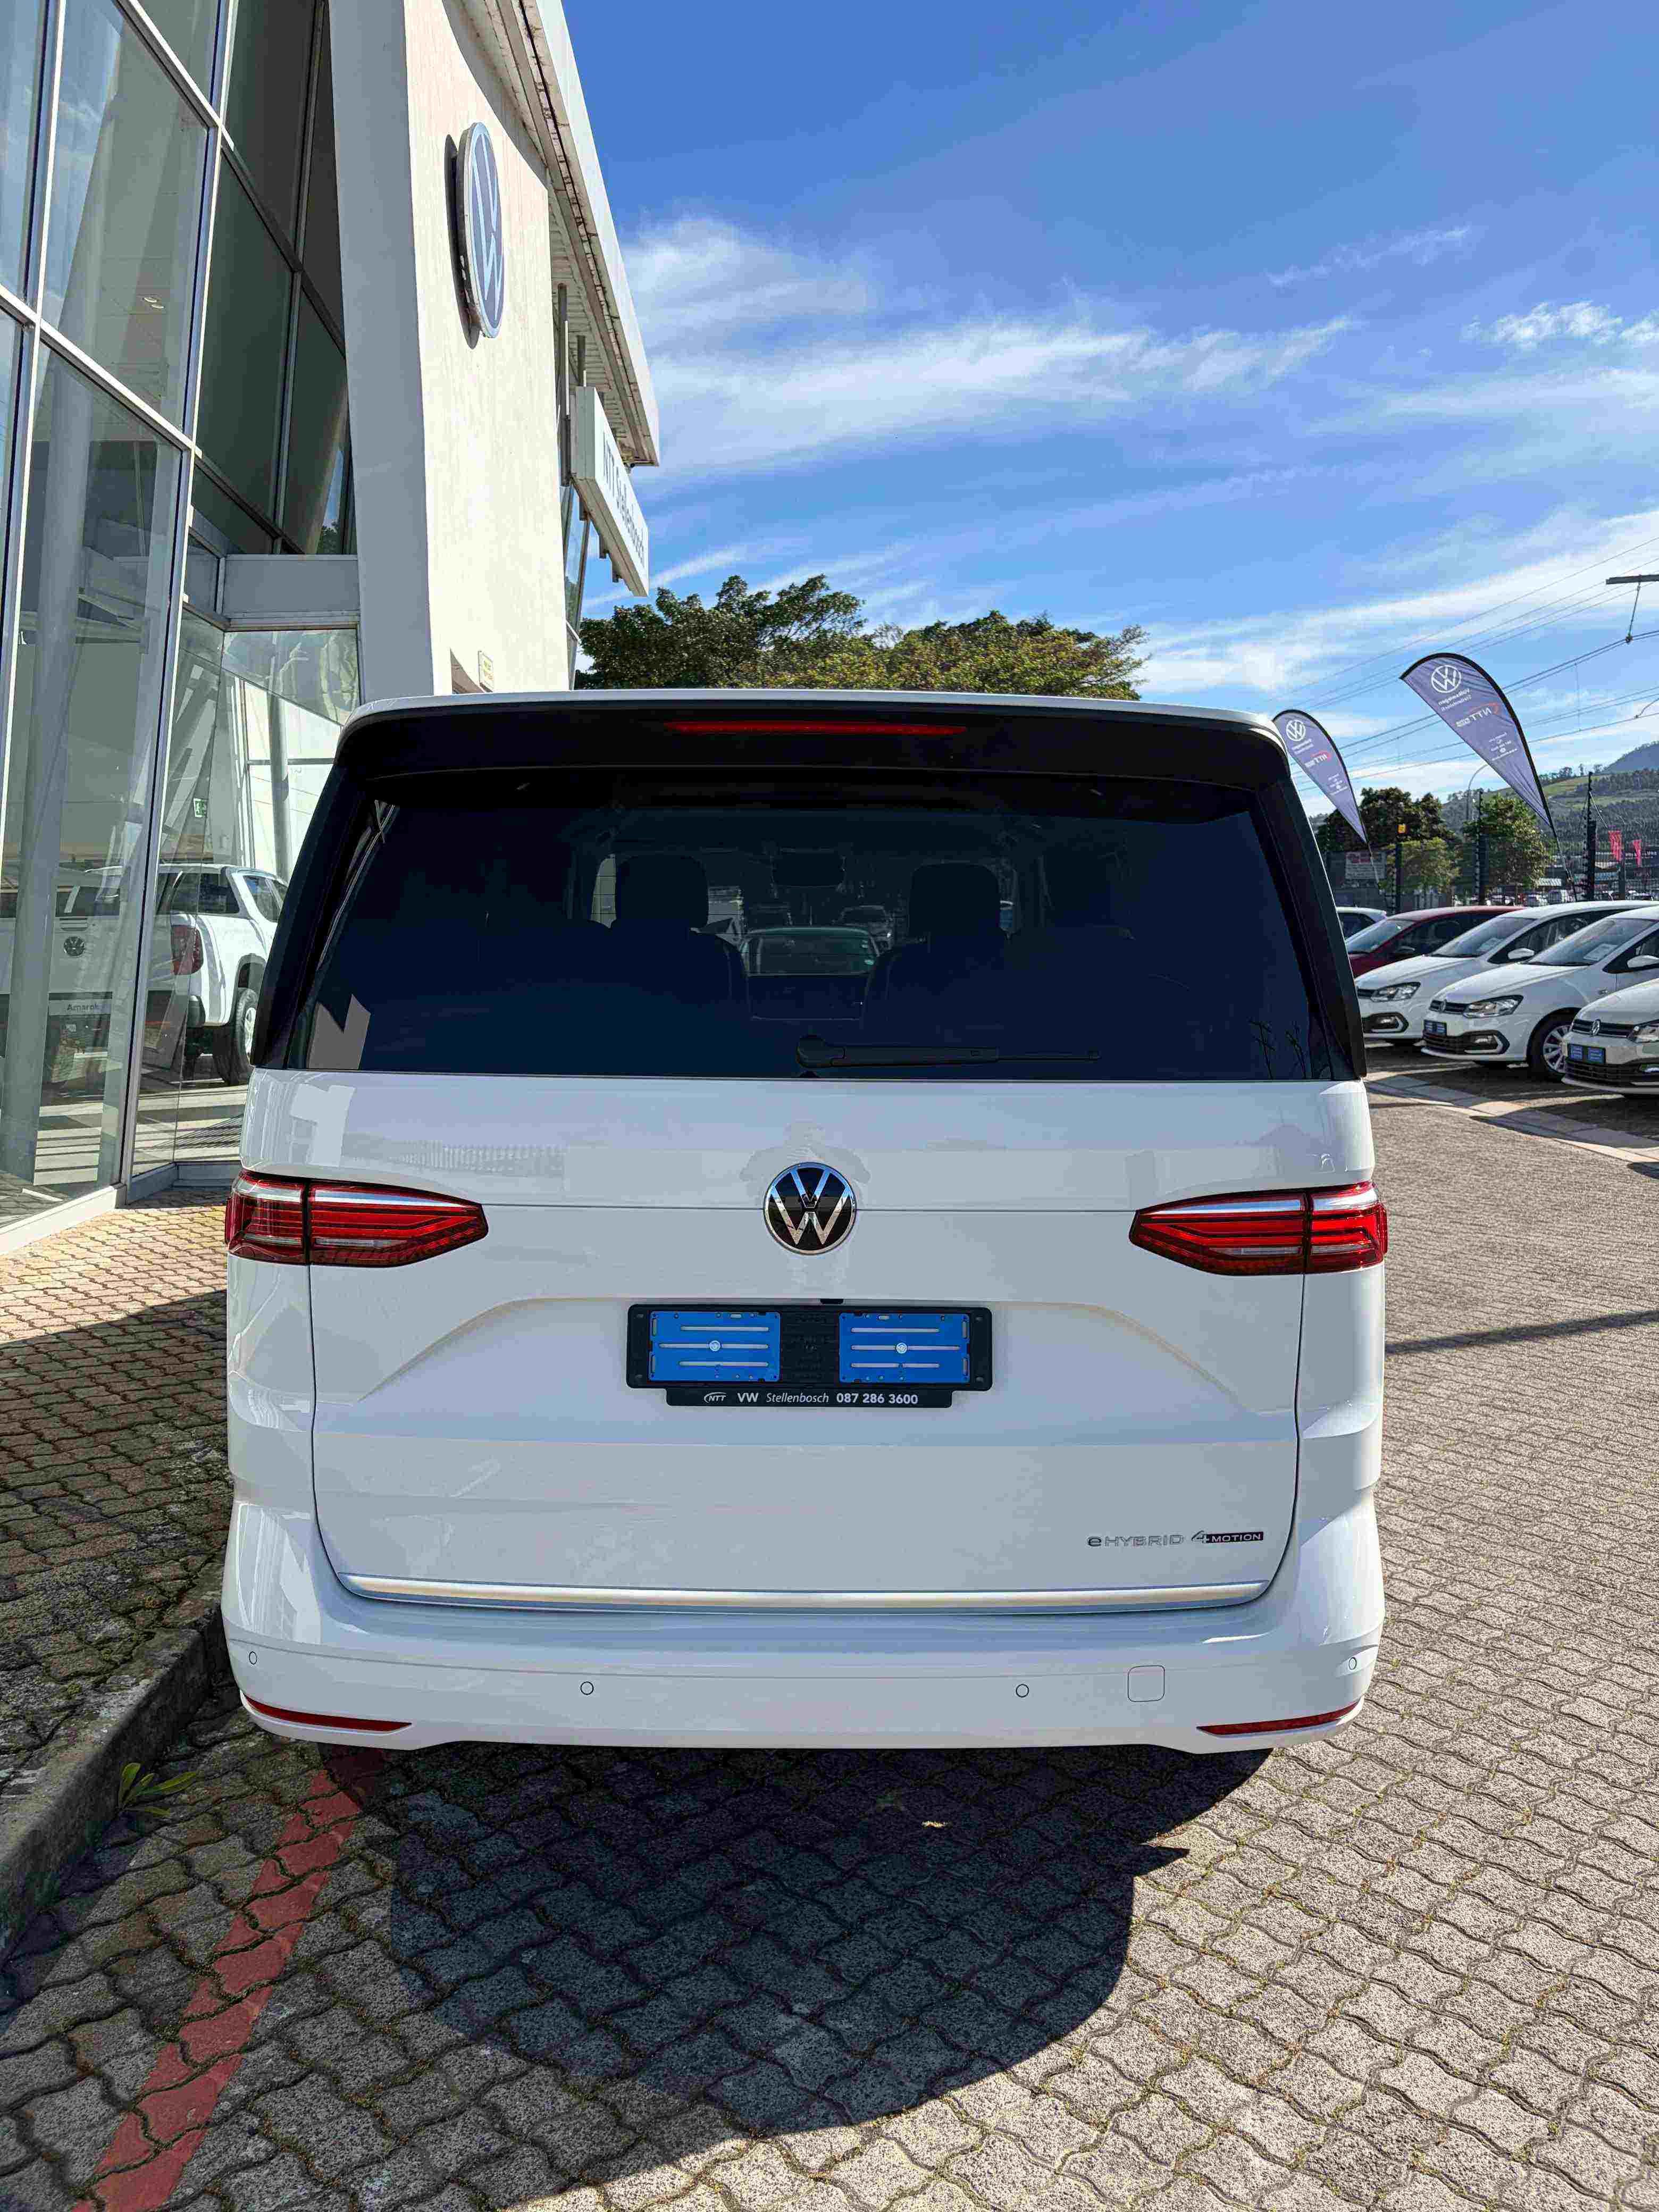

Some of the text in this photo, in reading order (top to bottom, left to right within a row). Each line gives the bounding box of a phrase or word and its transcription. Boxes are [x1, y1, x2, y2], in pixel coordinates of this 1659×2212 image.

[706, 1392, 919, 1404] NTT VW Stellenbosch 087 286 3600
